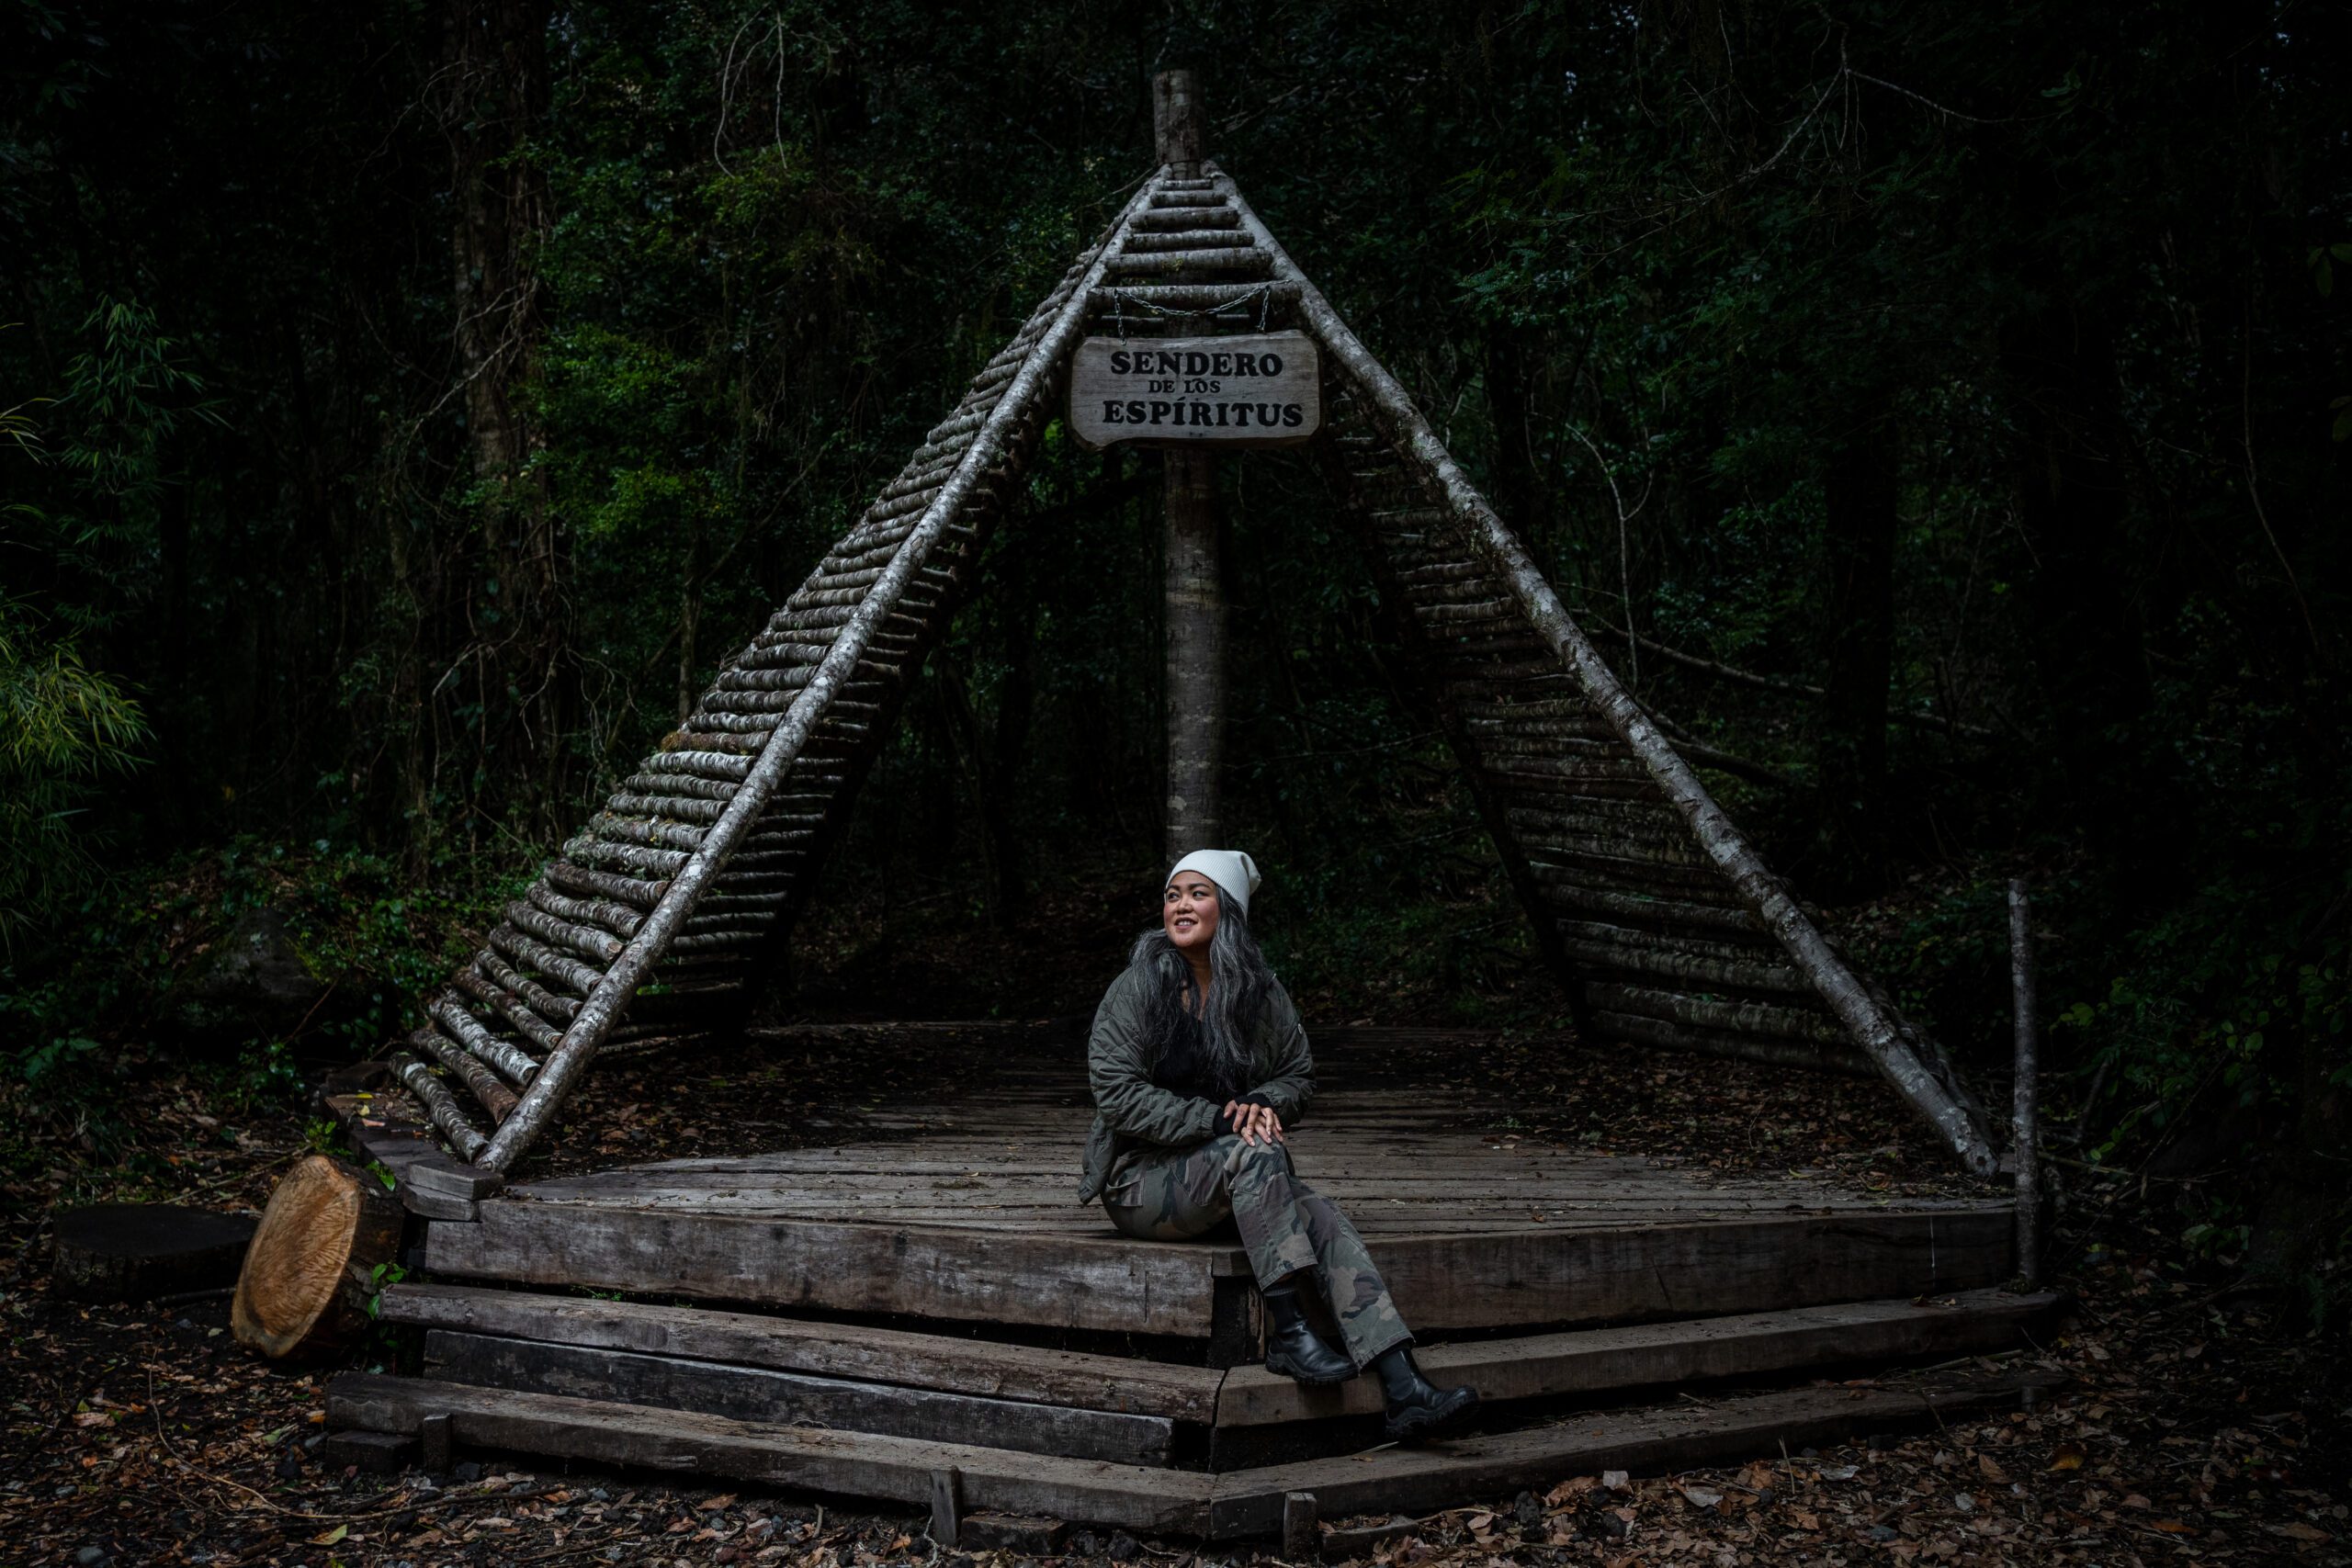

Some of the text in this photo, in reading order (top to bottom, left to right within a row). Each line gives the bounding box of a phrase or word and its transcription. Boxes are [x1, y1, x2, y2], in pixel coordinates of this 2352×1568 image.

[1111, 351, 1283, 377] SENDERO
[1148, 378, 1221, 394] DE LOS
[1102, 396, 1303, 426] ESPÍRITUS
